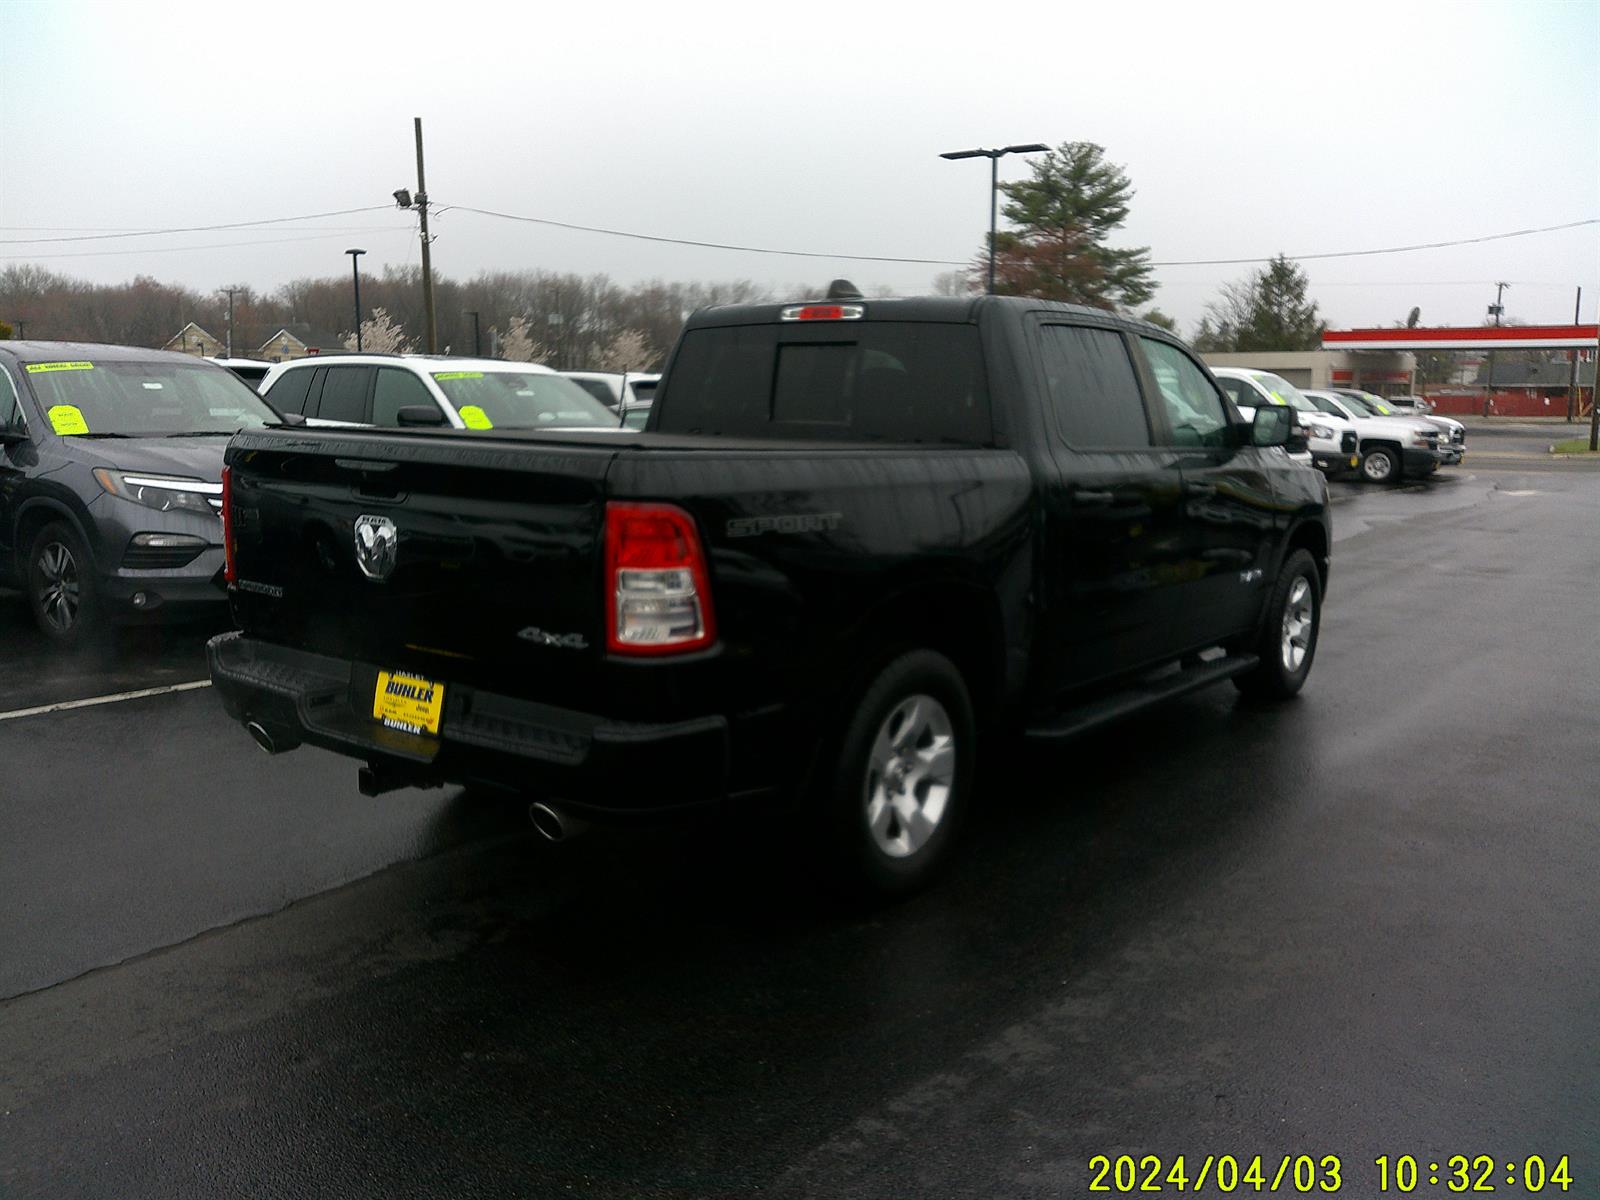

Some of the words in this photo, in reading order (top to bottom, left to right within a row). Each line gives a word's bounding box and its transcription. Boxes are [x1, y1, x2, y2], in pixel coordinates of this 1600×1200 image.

[727, 512, 843, 538] SPORT
[517, 626, 590, 649] 4x4
[385, 681, 434, 703] BUHLER
[384, 717, 421, 734] BUHLER
